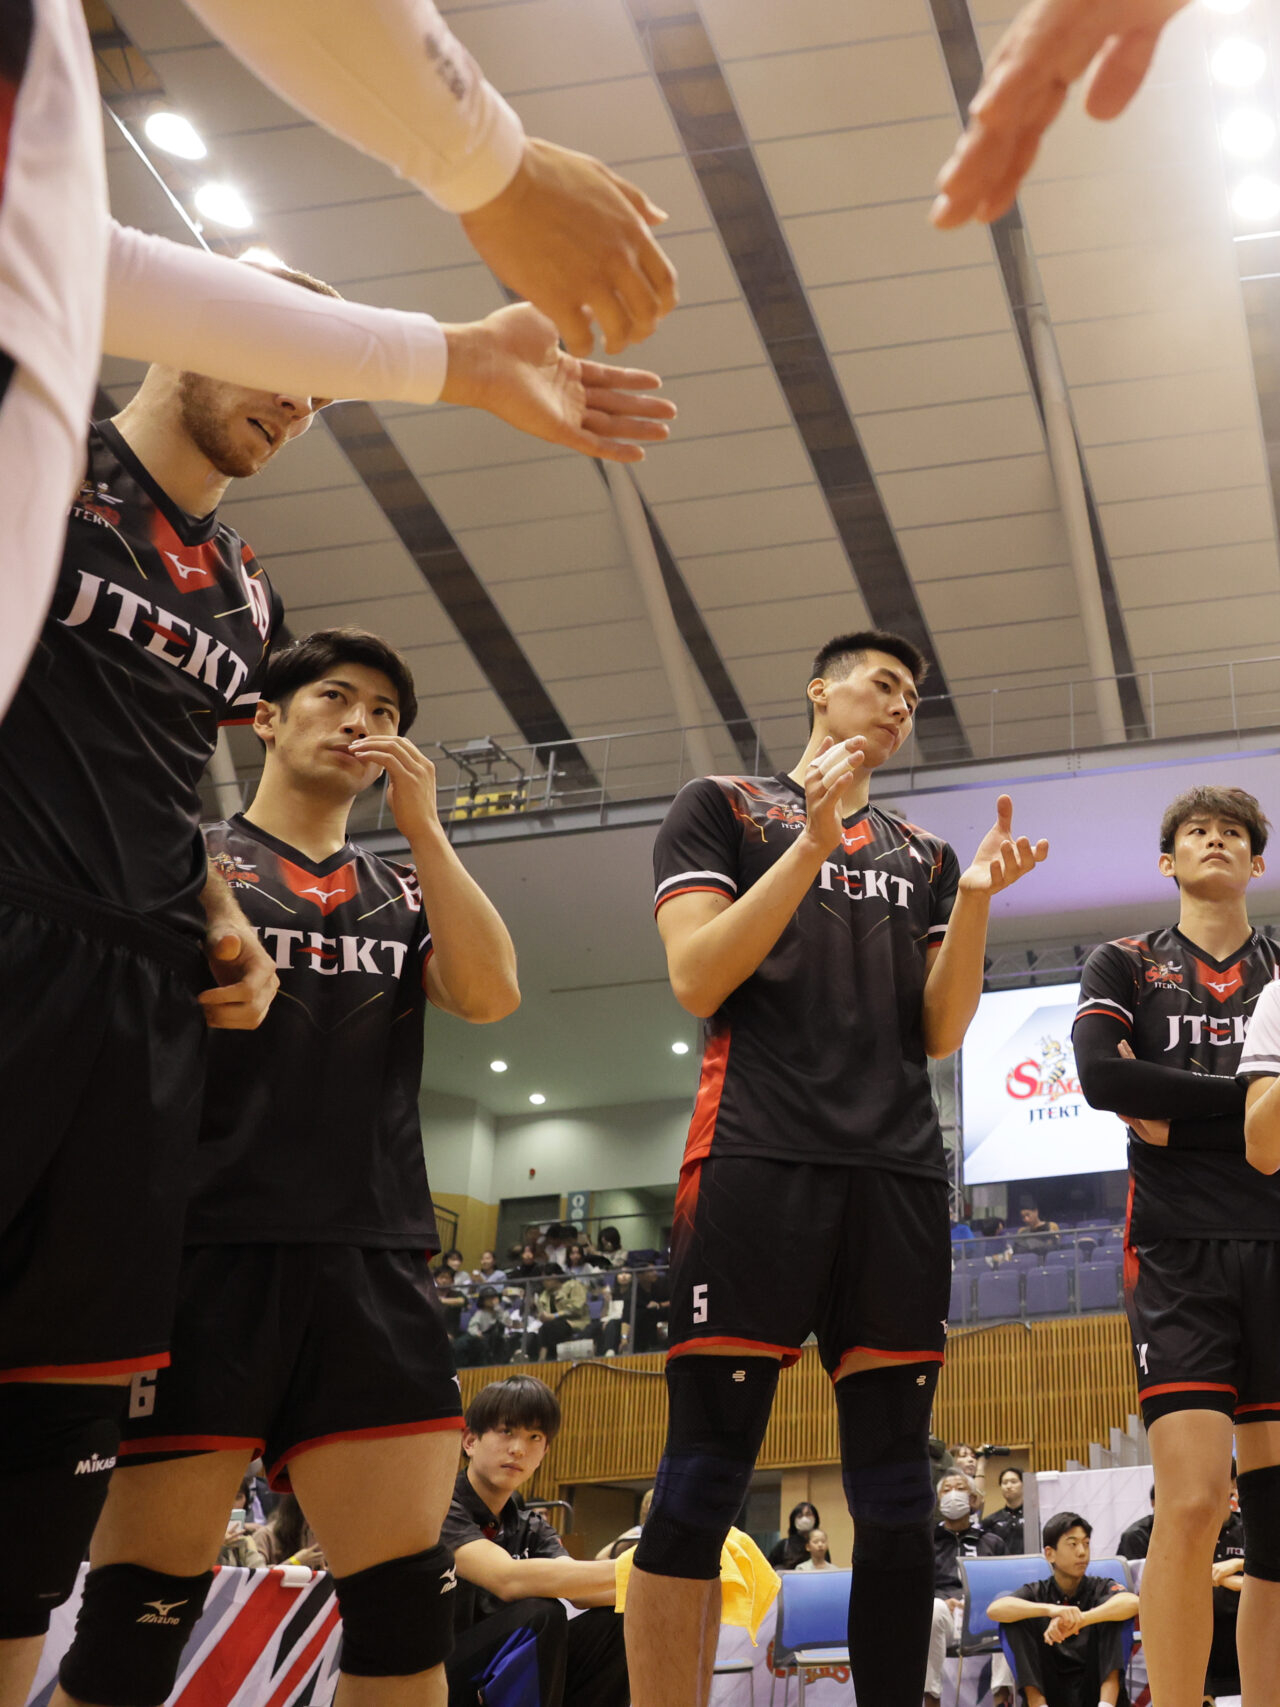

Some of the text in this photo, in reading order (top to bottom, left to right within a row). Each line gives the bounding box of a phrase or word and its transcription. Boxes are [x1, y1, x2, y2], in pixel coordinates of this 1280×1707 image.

[73, 506, 110, 528] TEKT
[57, 569, 249, 704] JTEKT
[818, 861, 914, 909] TEKT
[251, 926, 408, 979] TEKT
[1029, 1105, 1080, 1124] JTEKT
[693, 1284, 708, 1324] 5
[128, 1369, 158, 1419] 6
[74, 1453, 117, 1475] MIKAS
